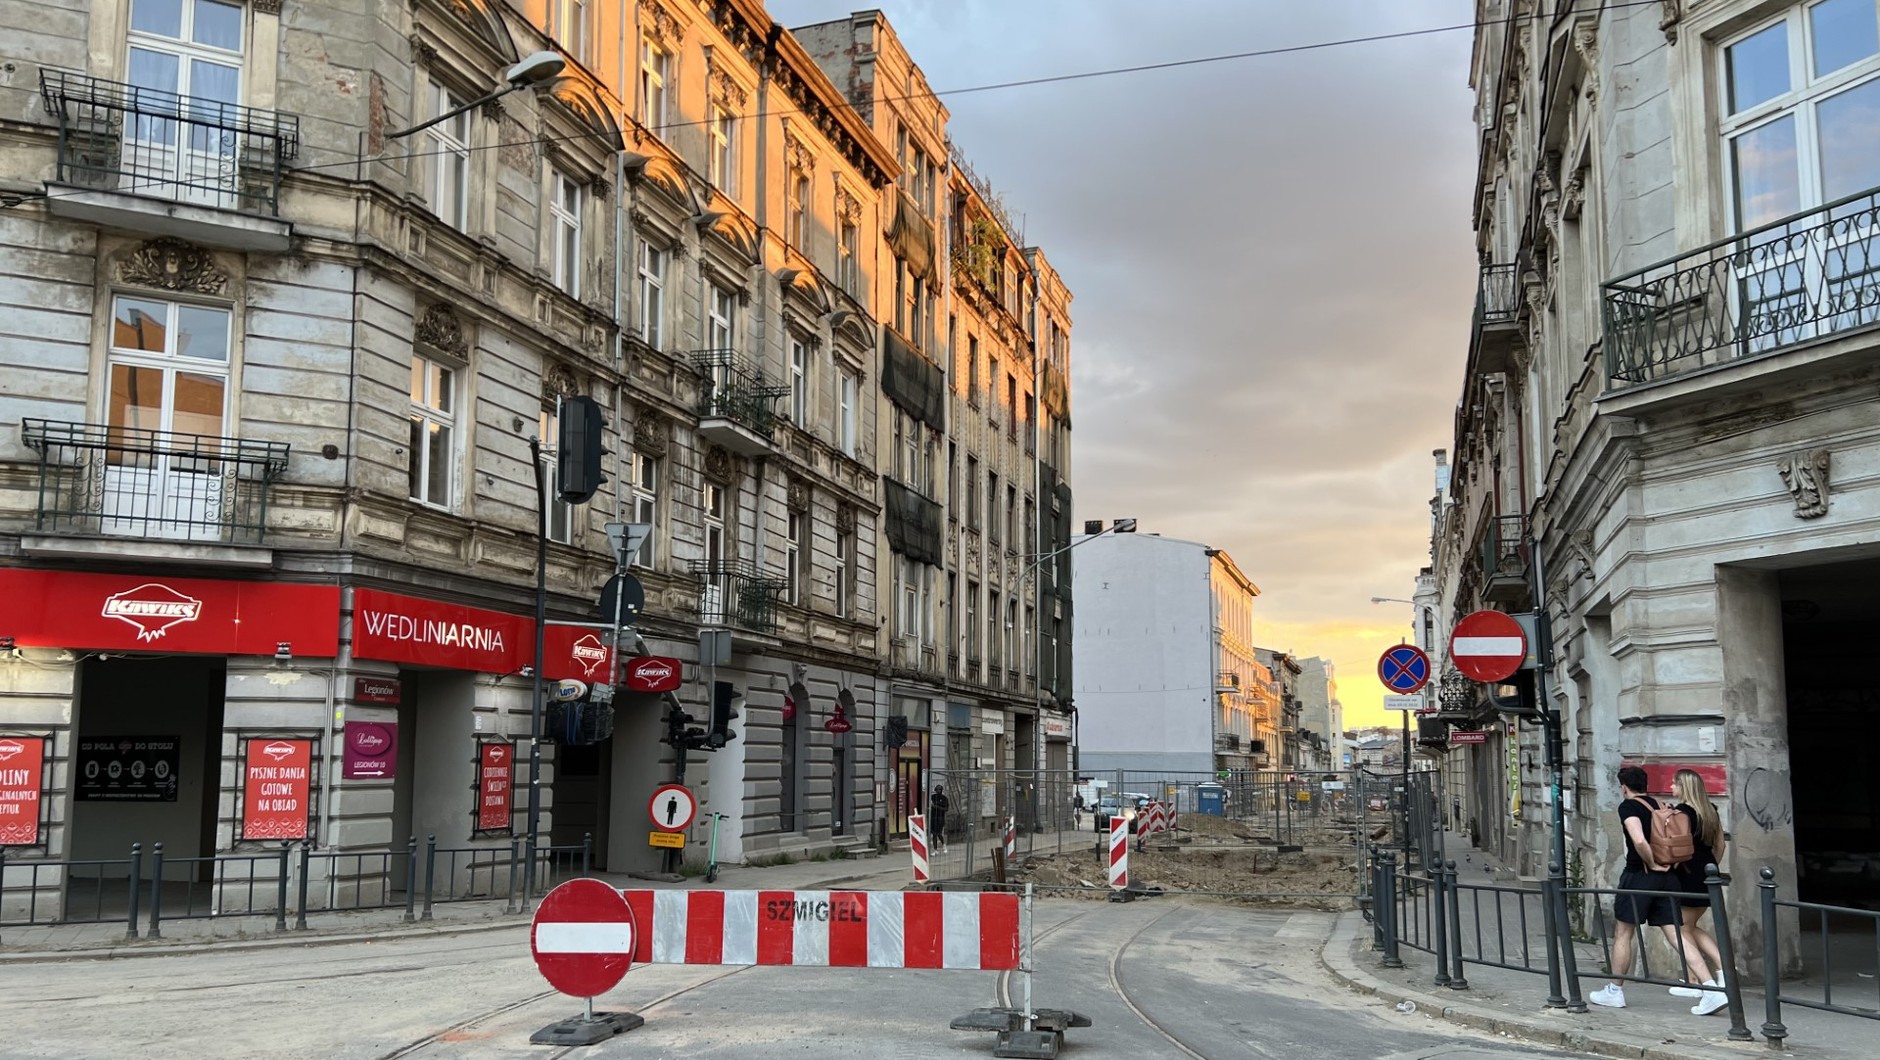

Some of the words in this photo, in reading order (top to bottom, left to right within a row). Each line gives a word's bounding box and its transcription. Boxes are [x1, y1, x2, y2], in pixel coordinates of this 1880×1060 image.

[363, 609, 505, 653] WĘDLINIARNIA
[364, 684, 394, 697] Legionów
[250, 767, 278, 780] PYSZNE
[279, 767, 305, 780] DANIA
[261, 783, 293, 796] GOTOWE
[258, 799, 270, 812] NA
[272, 799, 297, 812] OBIAD
[767, 900, 862, 922] SZMIGIEL
